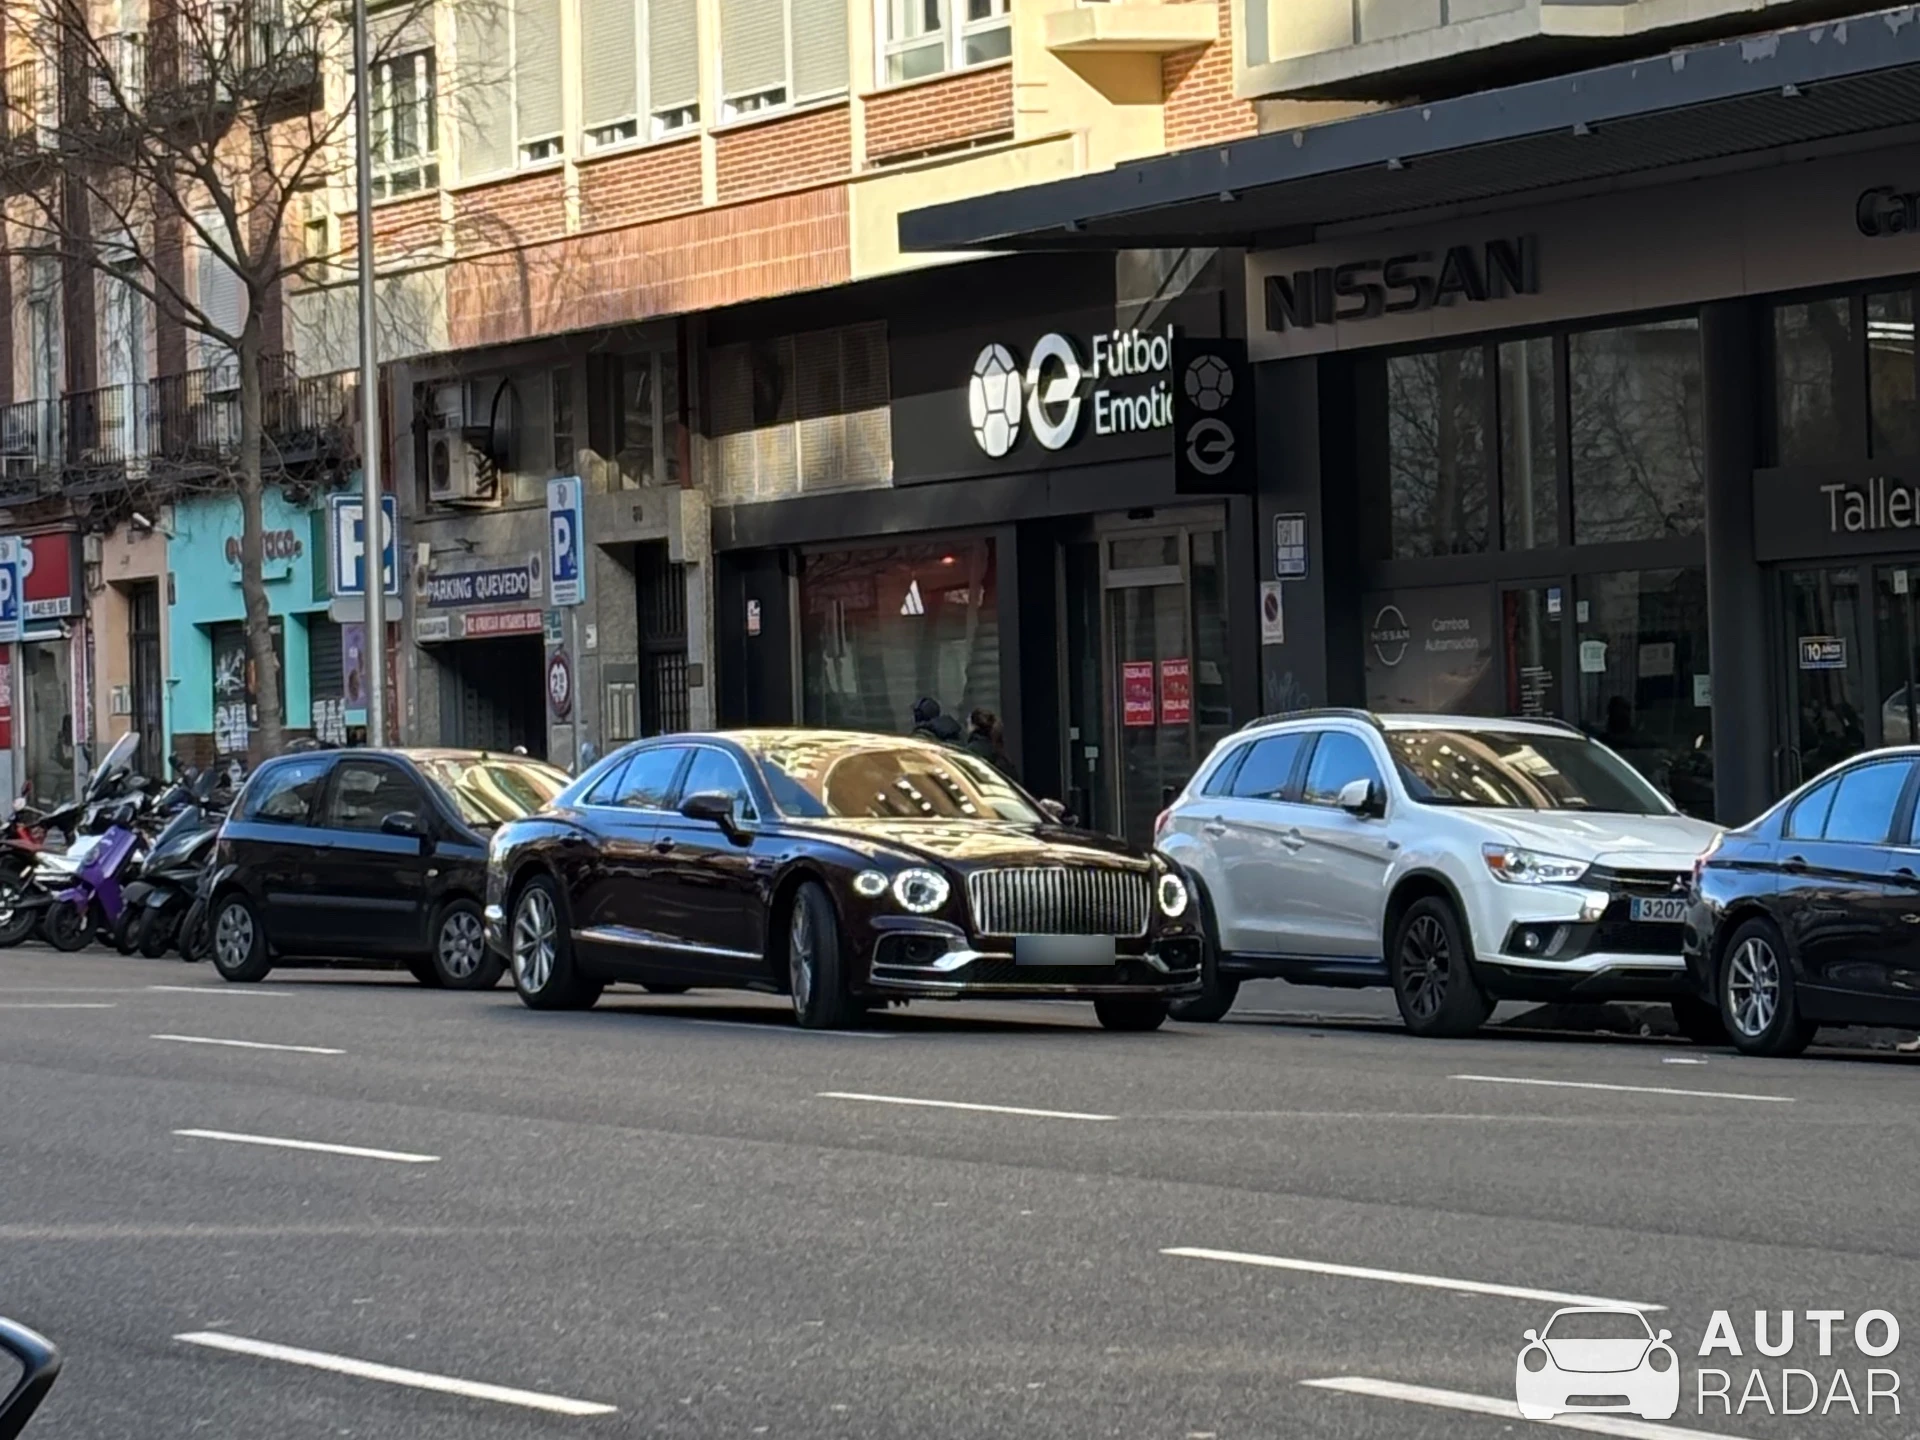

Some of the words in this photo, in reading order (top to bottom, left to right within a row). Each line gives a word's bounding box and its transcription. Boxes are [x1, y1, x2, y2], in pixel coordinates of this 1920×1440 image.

[1264, 232, 1539, 331] NISSAN
[1093, 323, 1173, 379] Fútbol
[340, 504, 391, 587] P
[552, 516, 570, 576] P
[427, 577, 472, 602] PARKING
[475, 572, 528, 599] QUEVEDO
[1371, 628, 1410, 642] NISSAN
[1642, 899, 1685, 919] 3207
